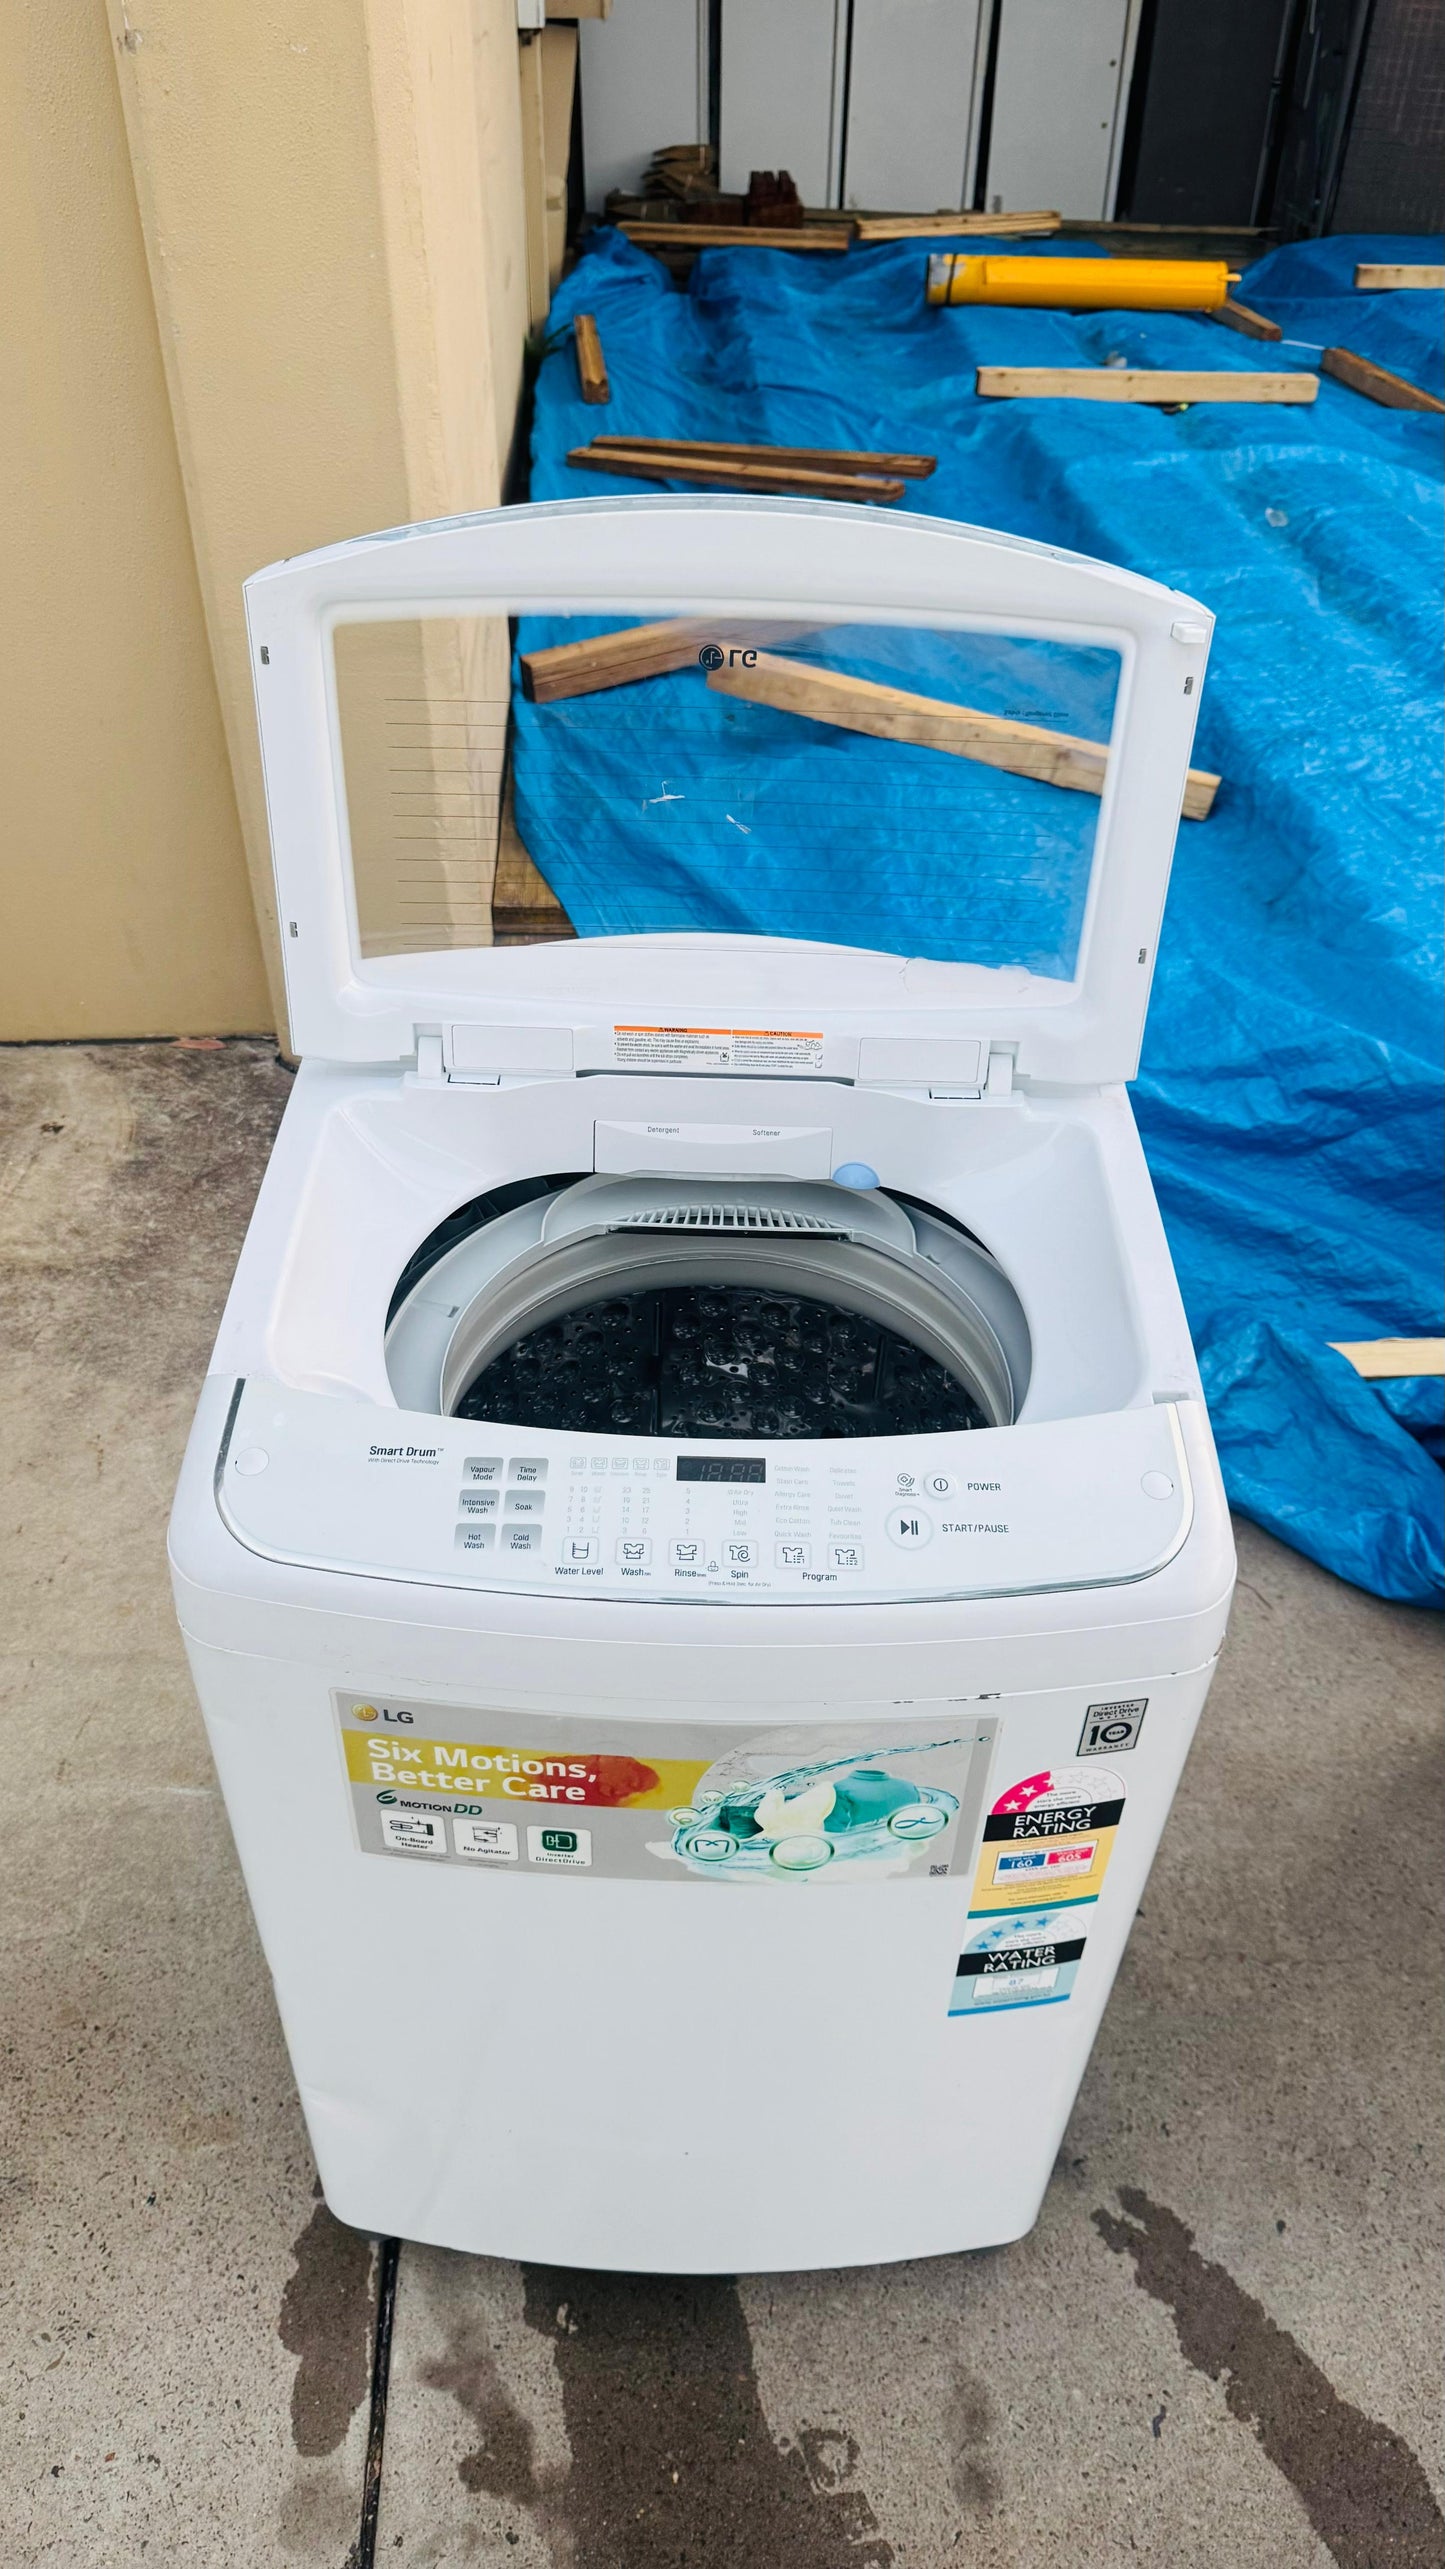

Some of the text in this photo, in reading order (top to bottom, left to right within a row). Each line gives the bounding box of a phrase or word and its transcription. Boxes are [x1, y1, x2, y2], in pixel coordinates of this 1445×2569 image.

[648, 1126, 680, 1134] Detergent
[752, 1129, 781, 1137] Softener
[370, 1446, 404, 1456] Smart
[406, 1447, 436, 1457] Drum
[470, 1466, 496, 1474] Vapour
[520, 1466, 537, 1474] Time
[517, 1474, 538, 1482] Delay
[968, 1483, 1002, 1491] POWER
[942, 1524, 1010, 1534] START/PAUSE
[468, 1533, 482, 1541] Hot
[513, 1534, 530, 1542] Cold
[464, 1542, 485, 1550] Wash
[510, 1542, 532, 1550] Wash
[555, 1567, 604, 1576] Water Level
[621, 1568, 644, 1576] Wash
[674, 1569, 697, 1578] Rinse
[731, 1570, 749, 1580] Spin
[802, 1572, 838, 1582] Program
[384, 1709, 414, 1724] LG
[1093, 1710, 1118, 1718] Direct
[1089, 1722, 1133, 1746] 10
[368, 1738, 598, 1784] Six Motions,
[372, 1762, 586, 1802] Better Care
[400, 1800, 452, 1813] MOTION
[454, 1804, 483, 1816] DD
[1014, 1806, 1097, 1827] ENERGY
[1013, 1819, 1092, 1838] RATING
[395, 1835, 434, 1845] On-Board
[401, 1842, 428, 1850] Heater
[477, 1847, 511, 1856] Agitator
[988, 1946, 1056, 1963] WATER
[983, 1956, 1056, 1974] RATING
